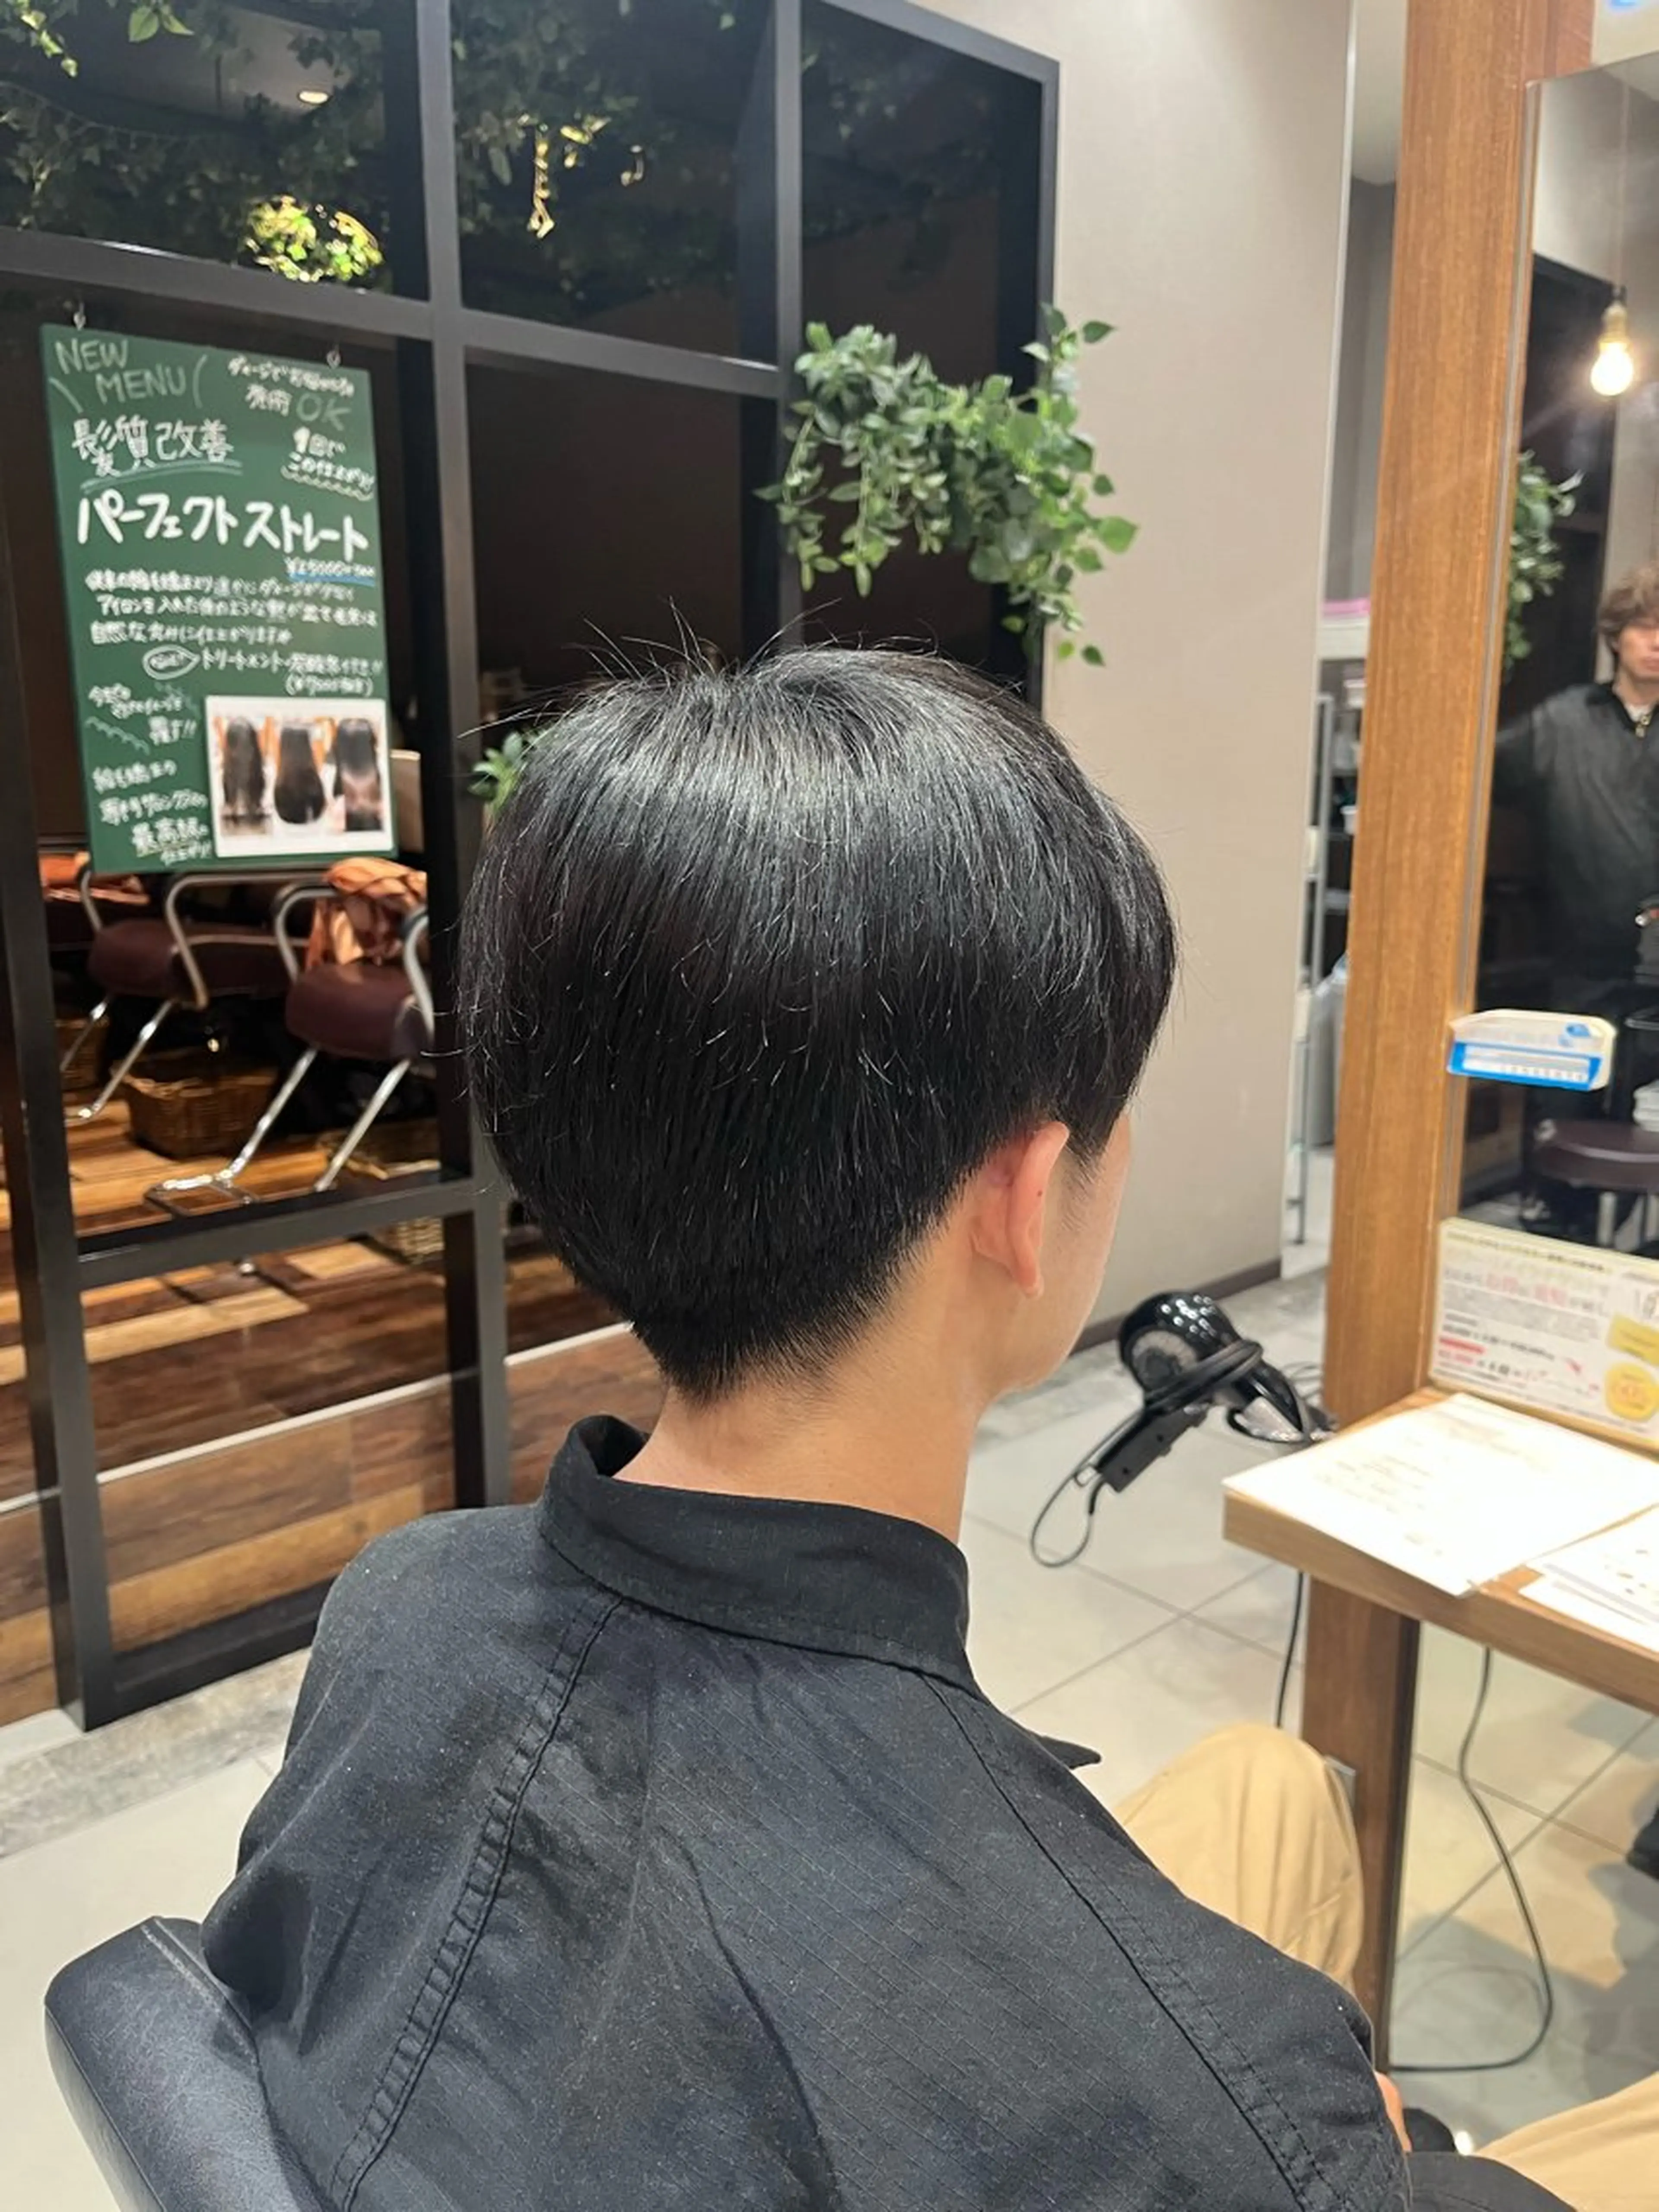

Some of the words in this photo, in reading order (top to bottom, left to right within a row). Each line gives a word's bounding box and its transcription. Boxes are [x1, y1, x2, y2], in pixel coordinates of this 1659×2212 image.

[56, 338, 128, 374] NEW
[95, 363, 186, 404] MENU
[296, 392, 352, 432] OK
[72, 414, 235, 478] 髪質改善
